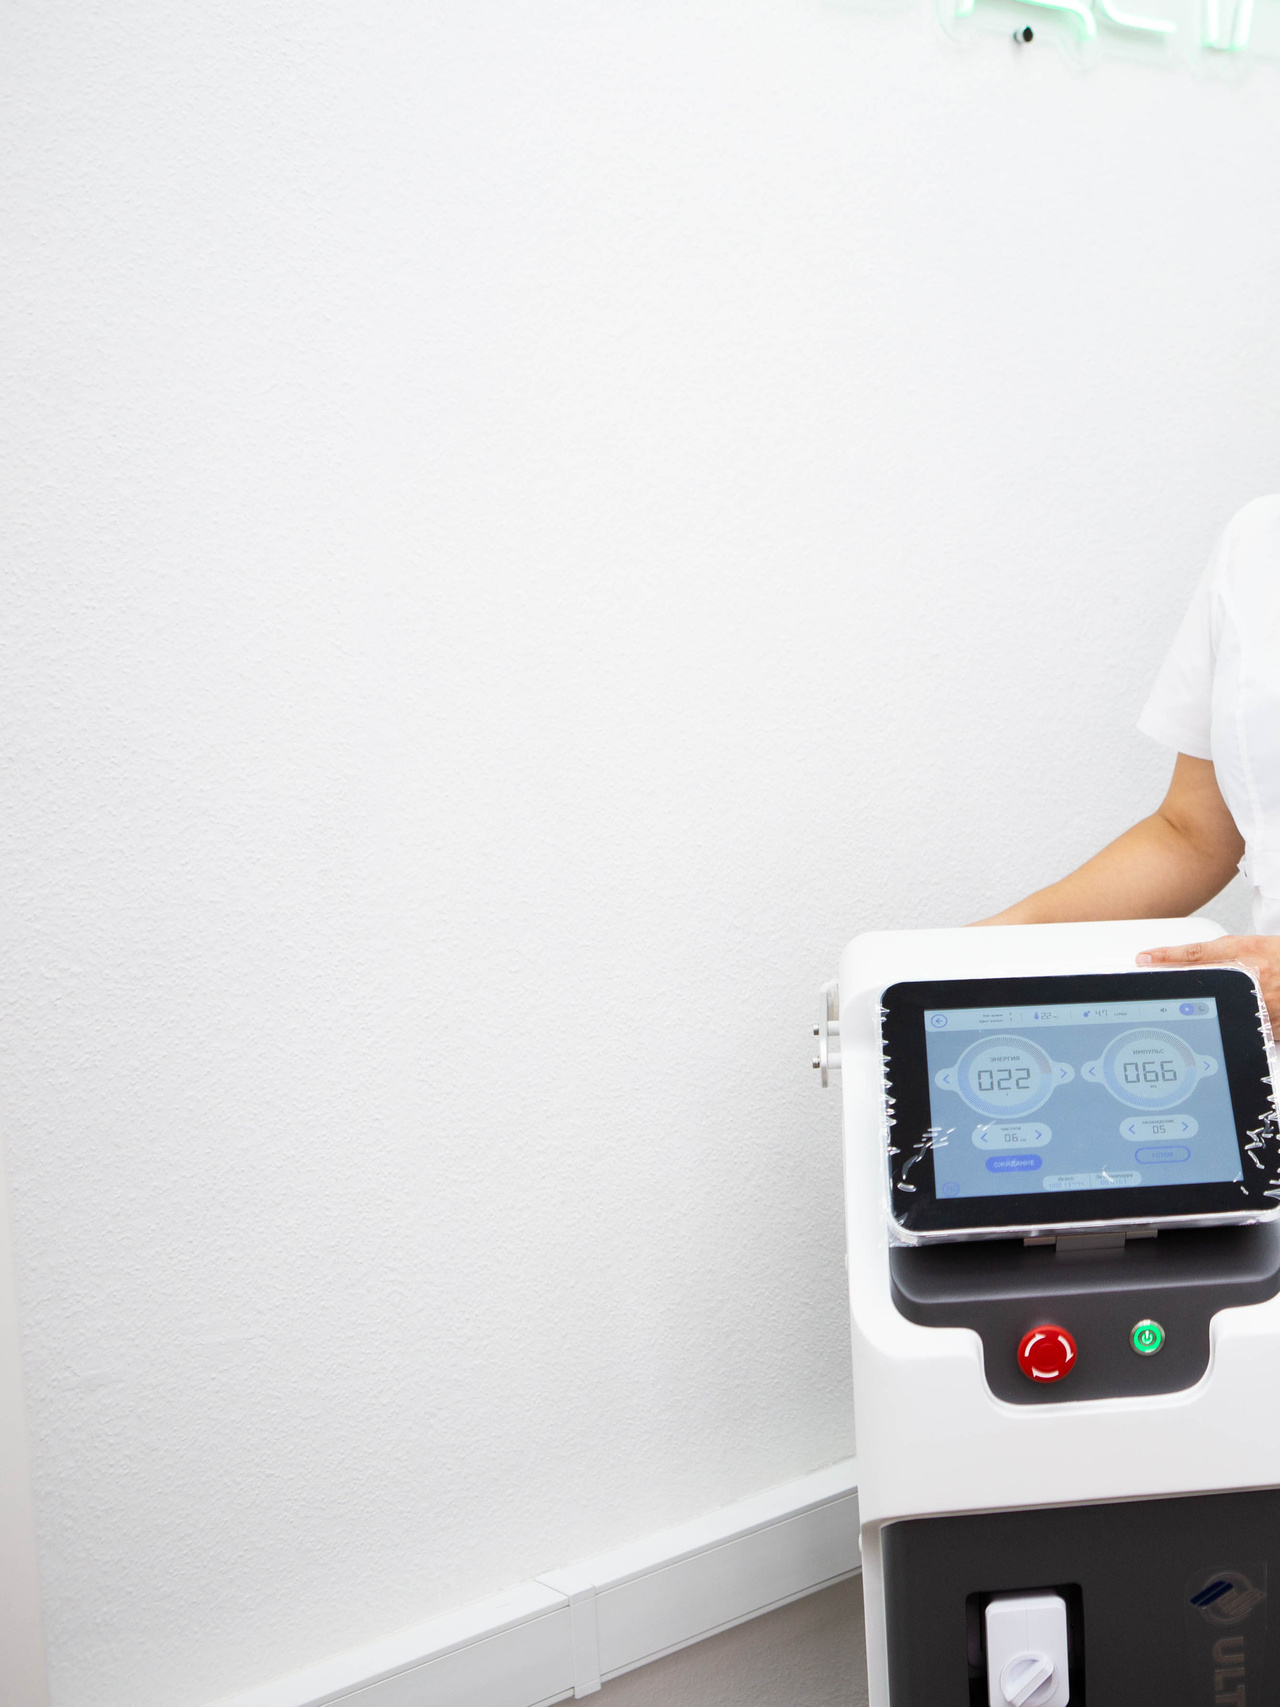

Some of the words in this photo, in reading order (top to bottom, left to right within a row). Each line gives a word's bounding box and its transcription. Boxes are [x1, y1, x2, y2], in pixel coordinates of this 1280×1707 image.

[990, 1055, 1021, 1063] ЭНЕРГИЯ
[1123, 1060, 1178, 1084] 066
[977, 1067, 1031, 1091] 022
[1152, 1125, 1167, 1134] 05
[1004, 1133, 1019, 1143] 06
[993, 1159, 1035, 1168] ОЖИДАНИЕ
